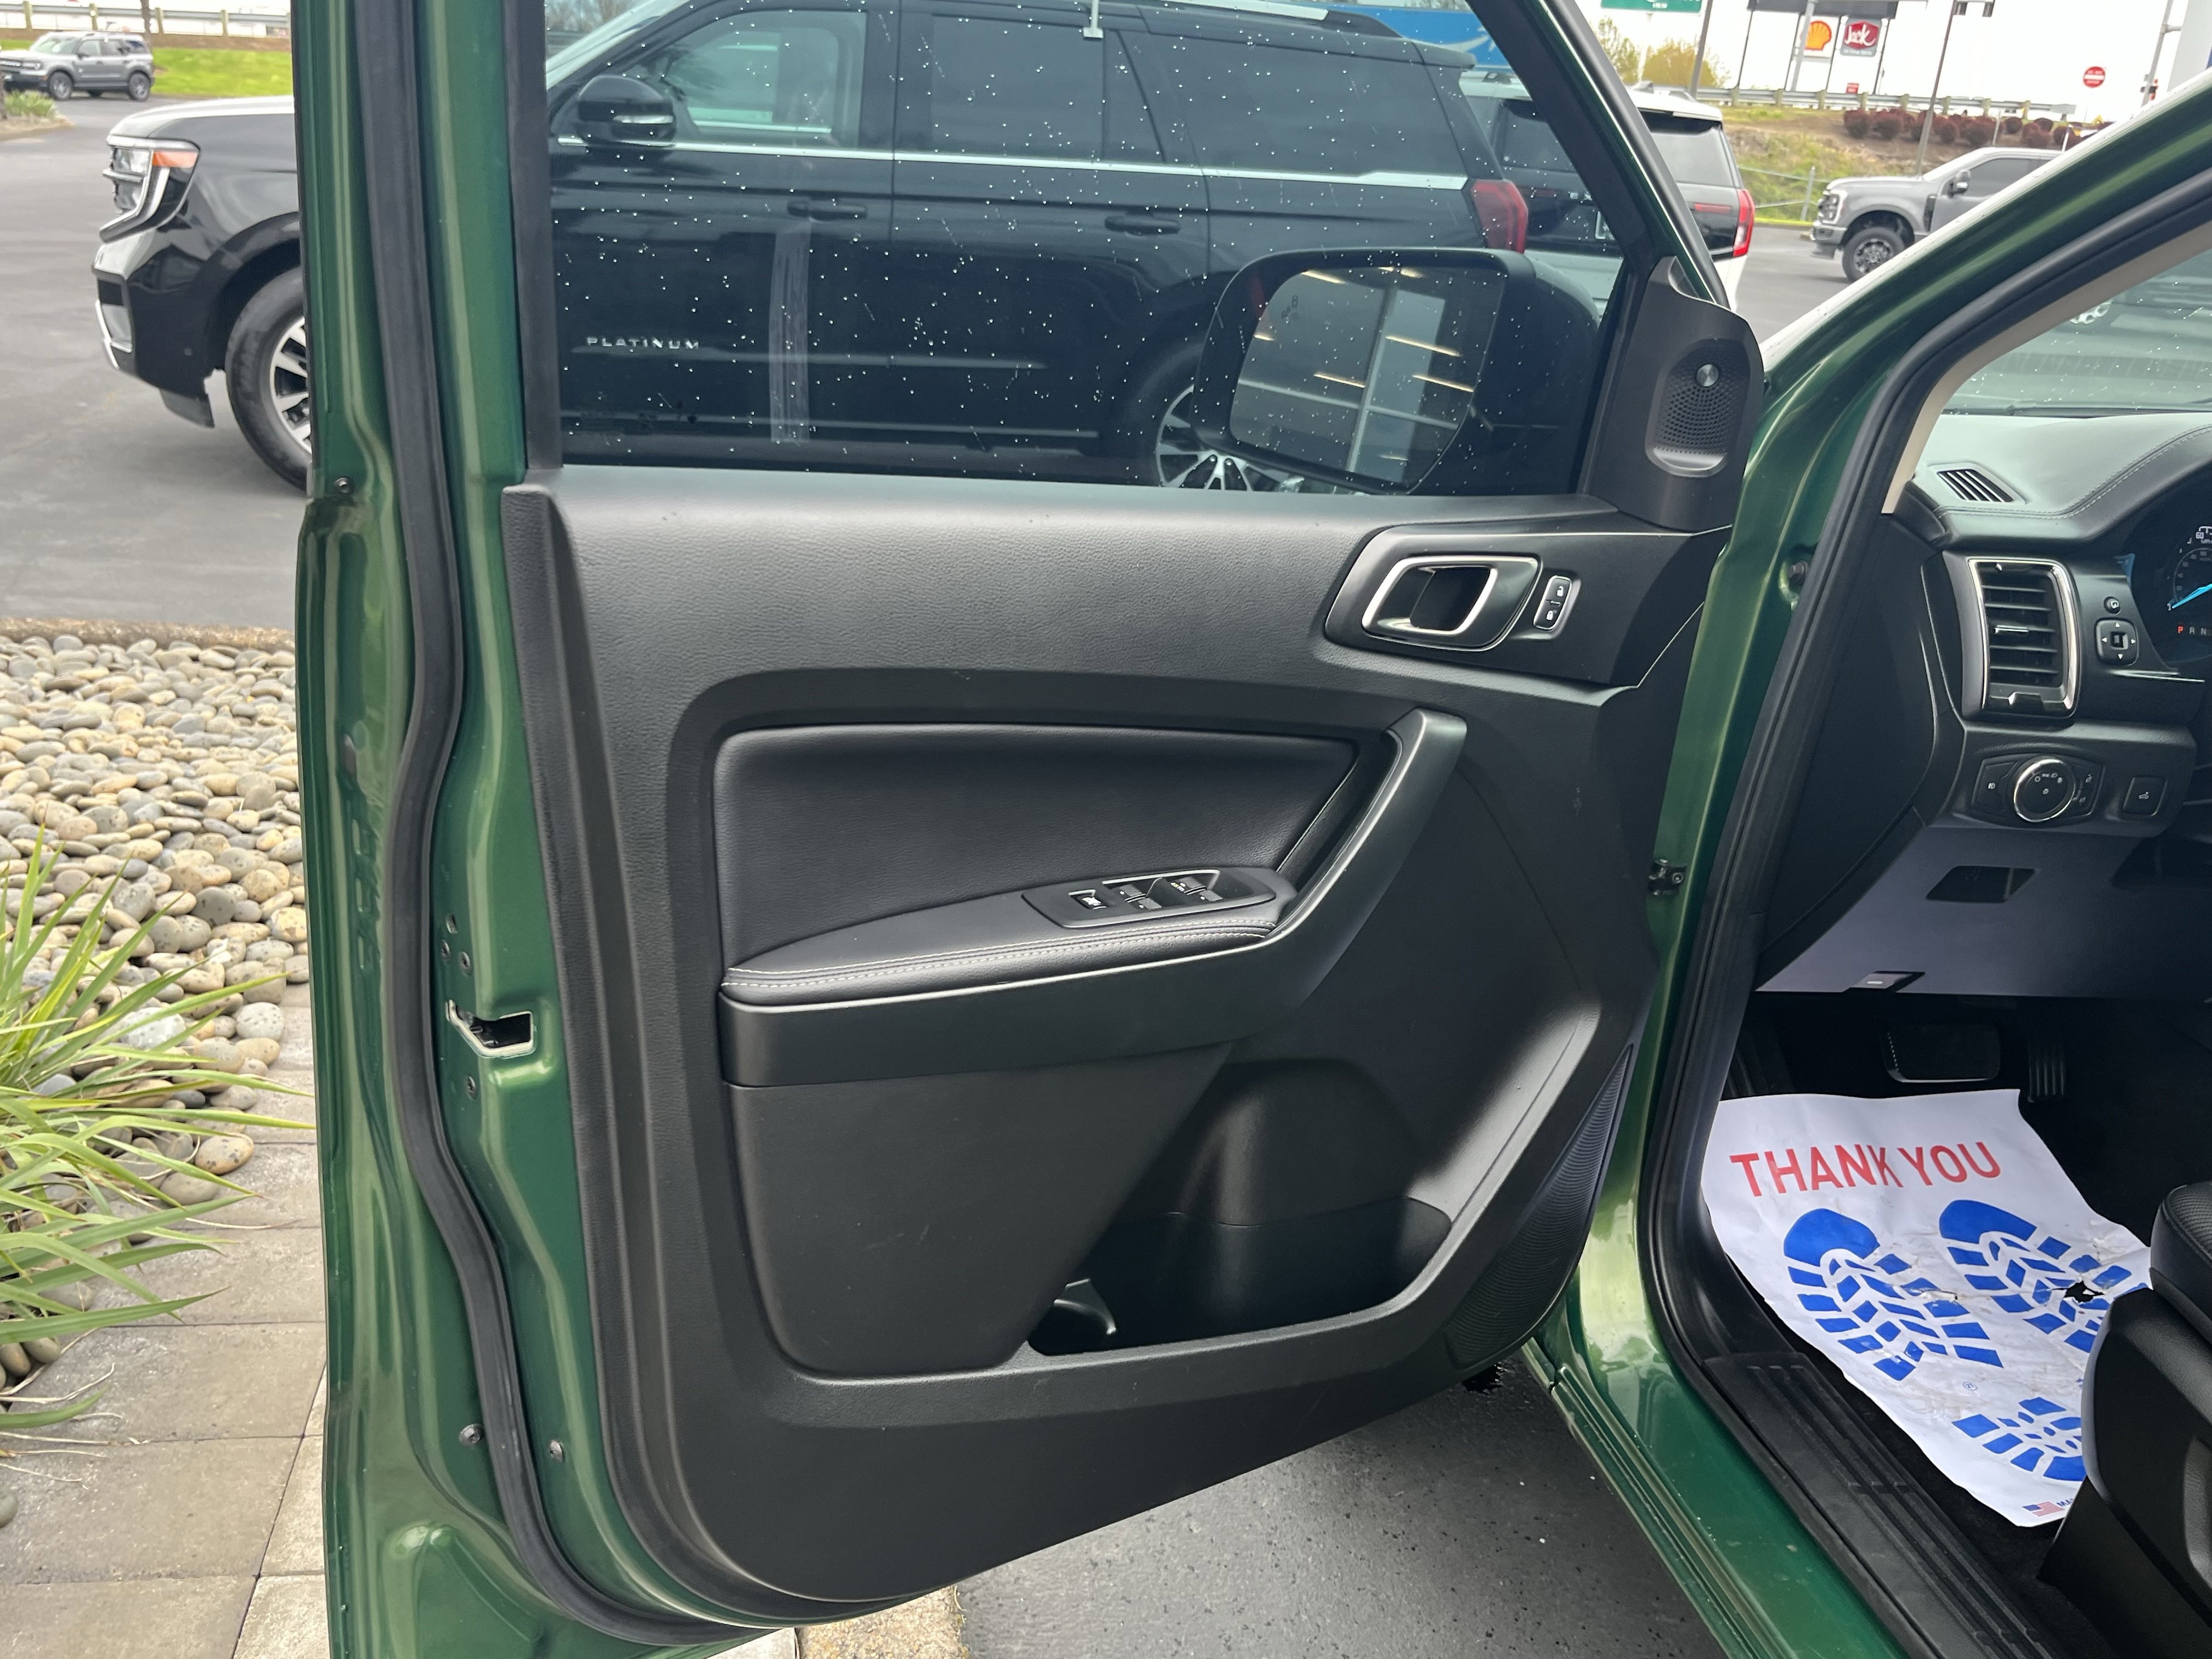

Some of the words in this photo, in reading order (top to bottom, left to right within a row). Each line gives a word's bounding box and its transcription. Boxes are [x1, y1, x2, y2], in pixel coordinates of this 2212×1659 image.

[1844, 24, 1876, 46] Jack
[586, 336, 699, 349] PLATINUM
[1729, 1144, 1904, 1197] THANK
[1897, 1141, 2001, 1186] YOU
